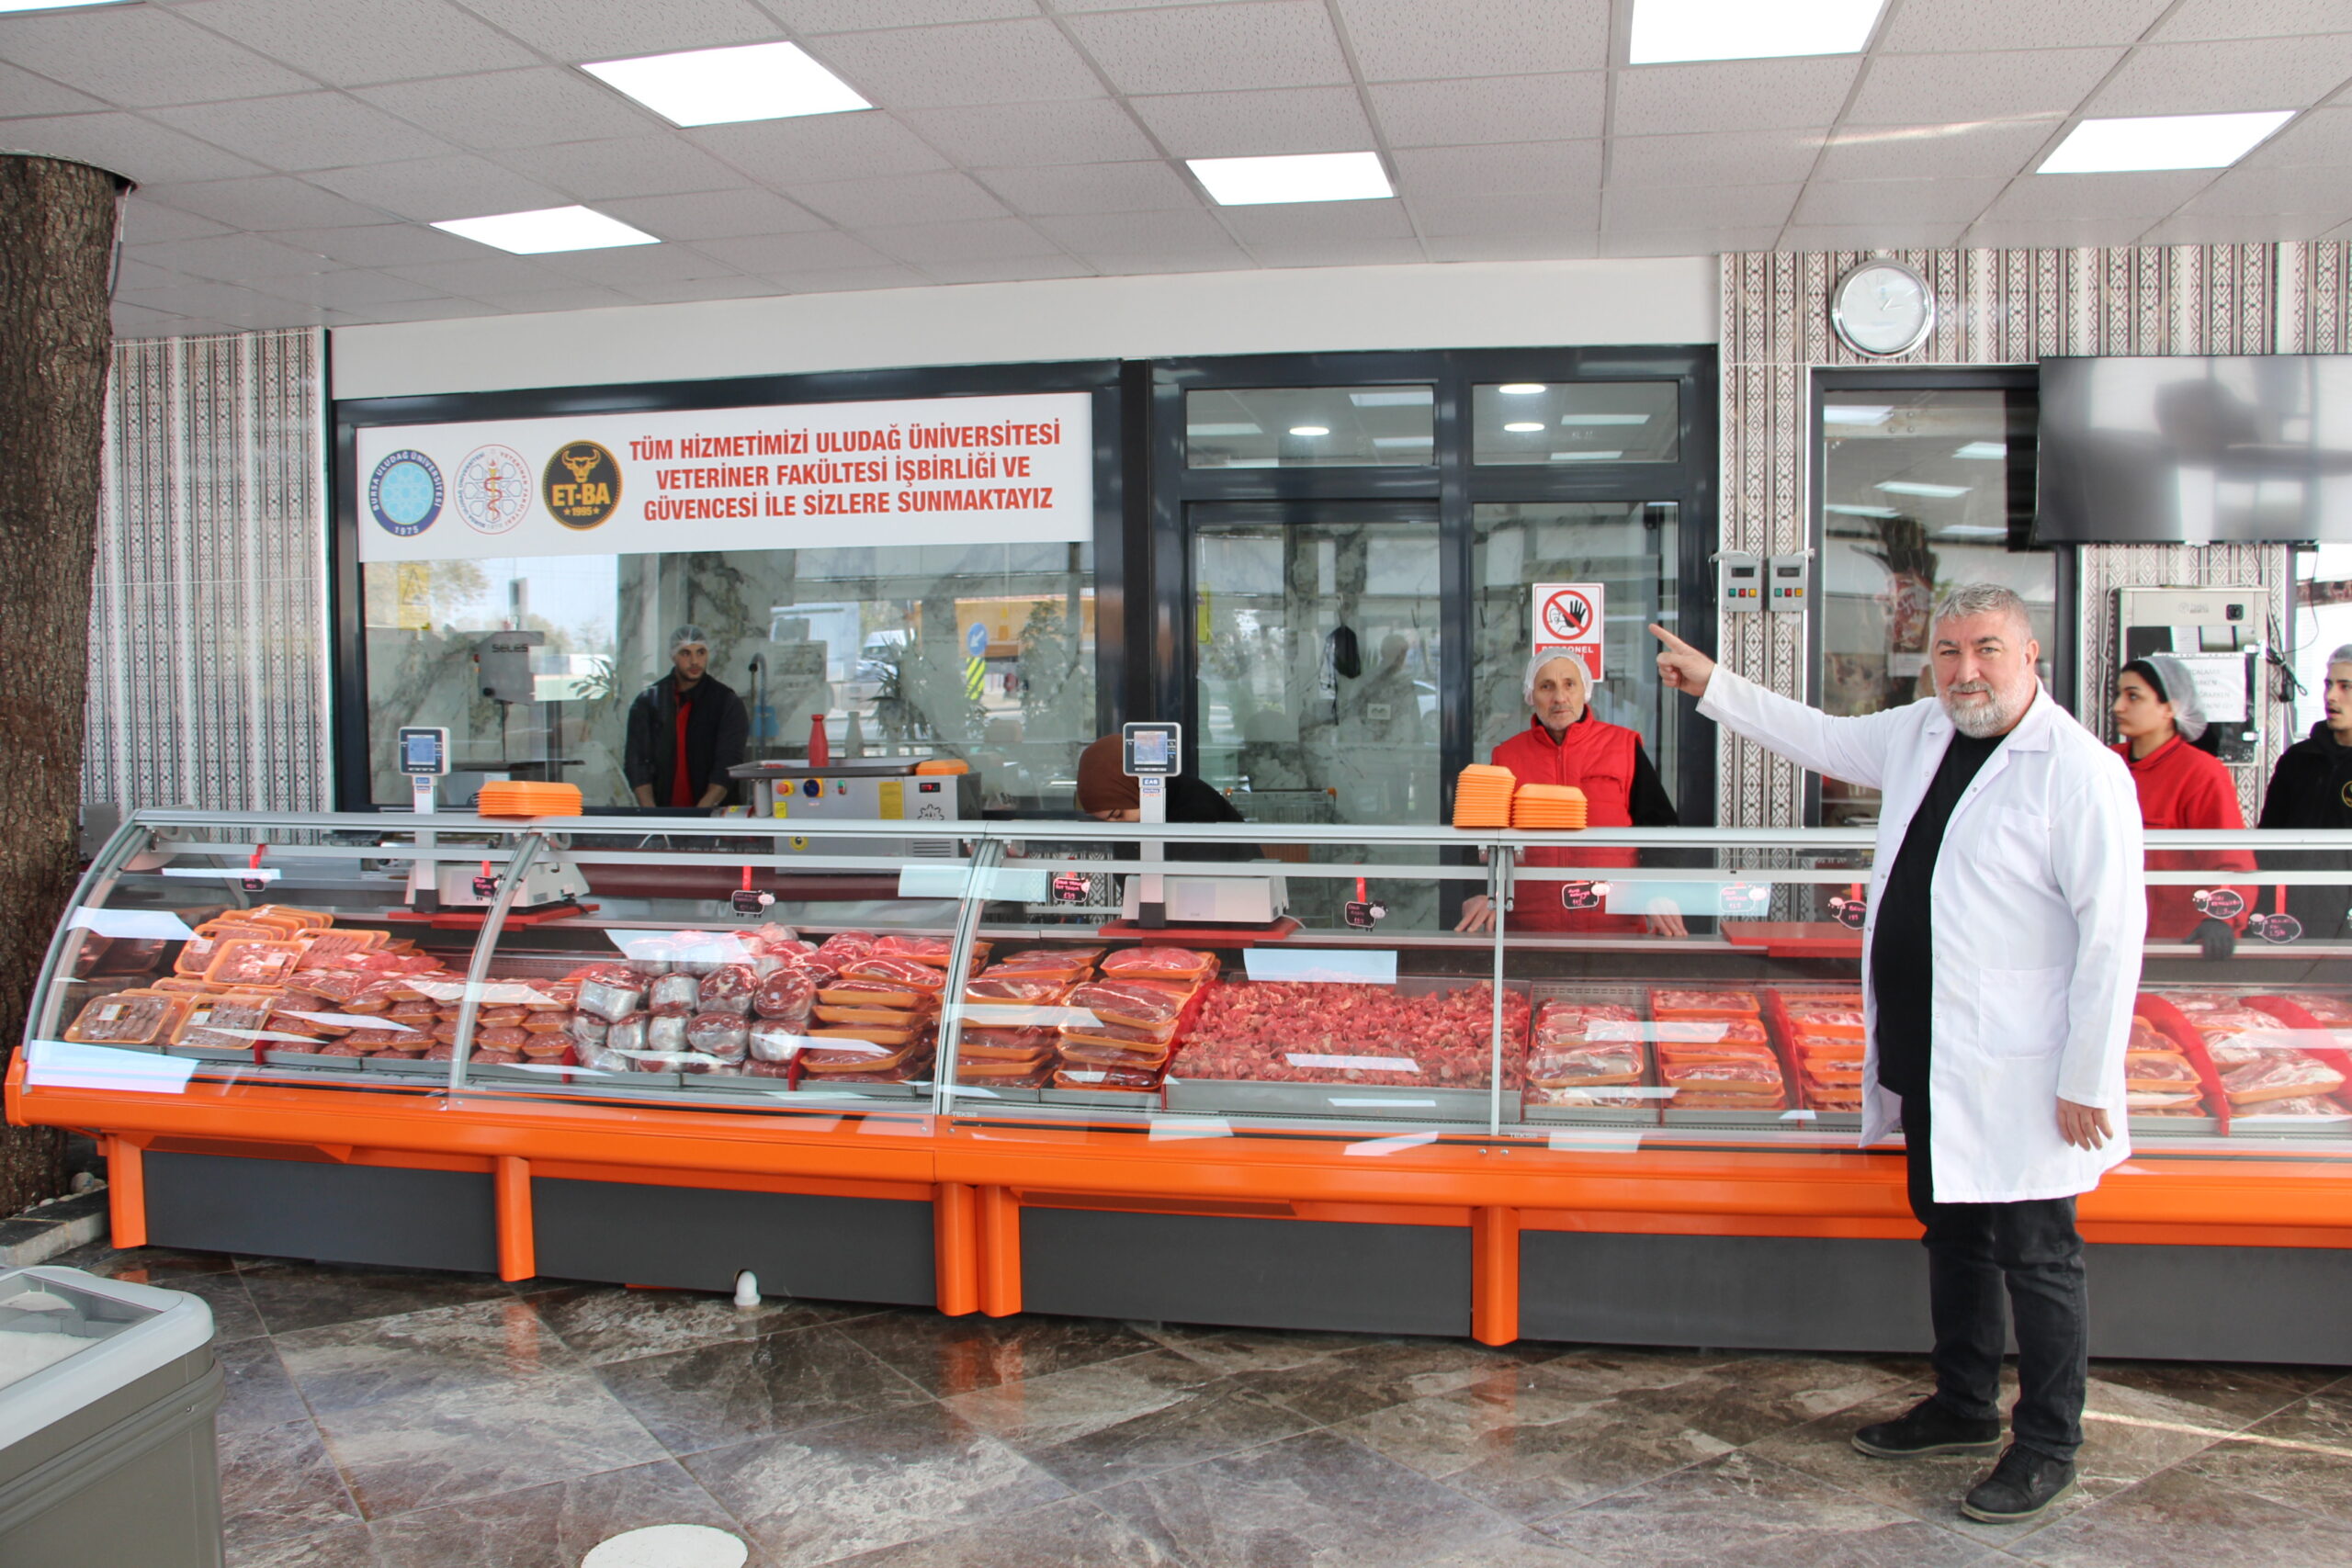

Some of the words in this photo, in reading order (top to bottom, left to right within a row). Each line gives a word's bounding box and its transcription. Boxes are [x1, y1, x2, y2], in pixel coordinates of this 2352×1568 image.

[629, 434, 673, 460] TÜM
[681, 428, 808, 458] HİZMETİMİZİ
[816, 423, 900, 453] ULUDAĞ
[909, 418, 1060, 449] ÜNİVERSİTESİ
[656, 462, 769, 490] VETERİNER
[776, 456, 888, 486] FAKÜLTESİ
[895, 451, 996, 488] İŞBİRLİĞİ
[1002, 456, 1031, 478] VE
[370, 478, 380, 512] BURSA
[551, 482, 611, 506] ET-BA
[571, 506, 594, 516] 1995
[644, 491, 758, 521] GÜVENCESİ
[765, 491, 796, 516] İLE
[803, 489, 890, 514] SİZLERE
[898, 487, 1053, 513] SUNMAKTAYIZ
[394, 525, 419, 536] 1975
